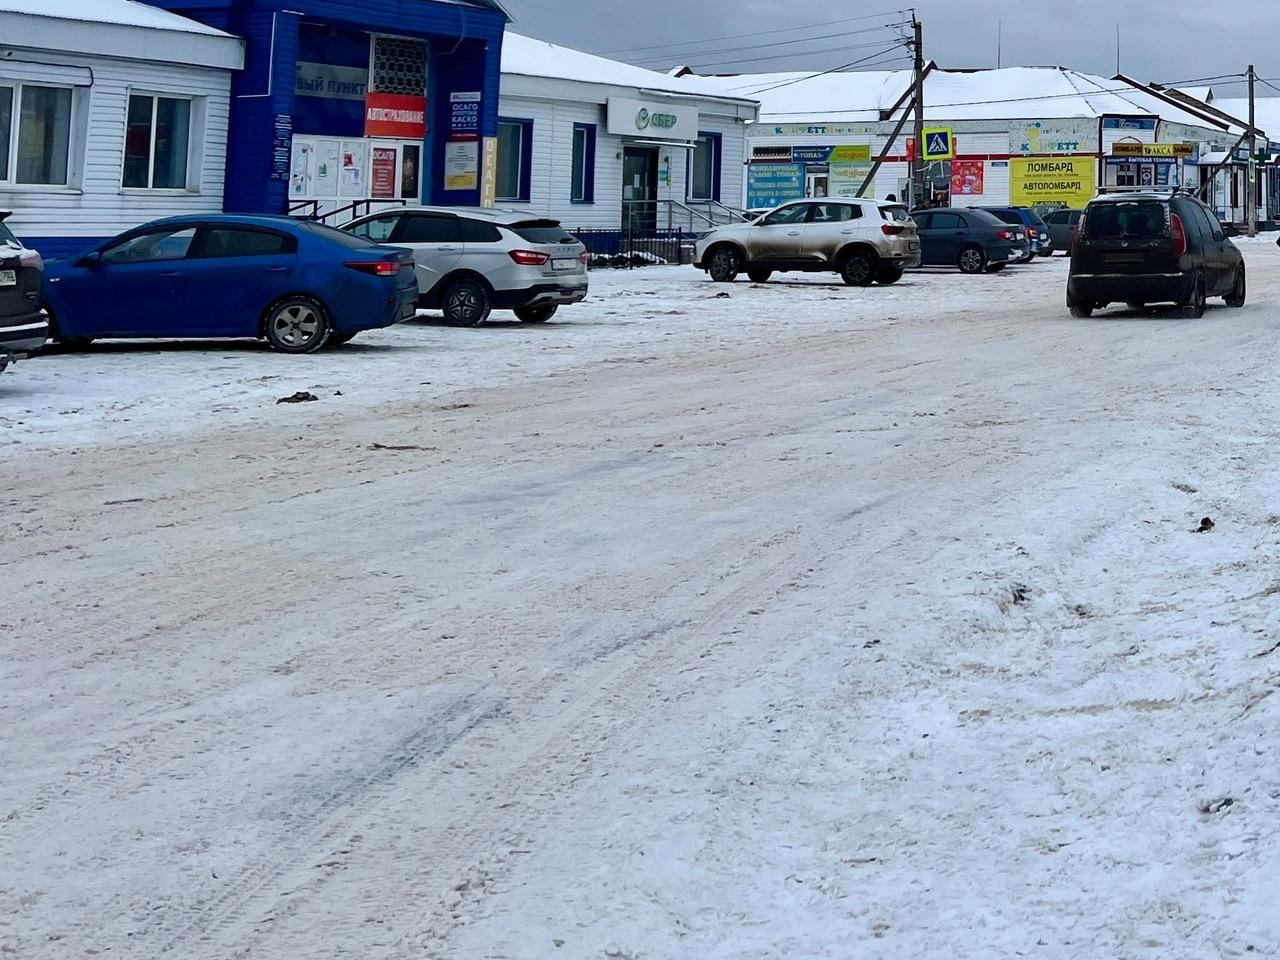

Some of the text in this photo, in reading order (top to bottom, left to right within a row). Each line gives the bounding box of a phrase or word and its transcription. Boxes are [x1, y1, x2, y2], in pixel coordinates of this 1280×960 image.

[452, 103, 479, 111] ОСАГО
[651, 112, 677, 128] СБЕР
[1027, 162, 1073, 173] ЛОМБАРД
[1022, 181, 1081, 191] АВТОЛОМБАРД
